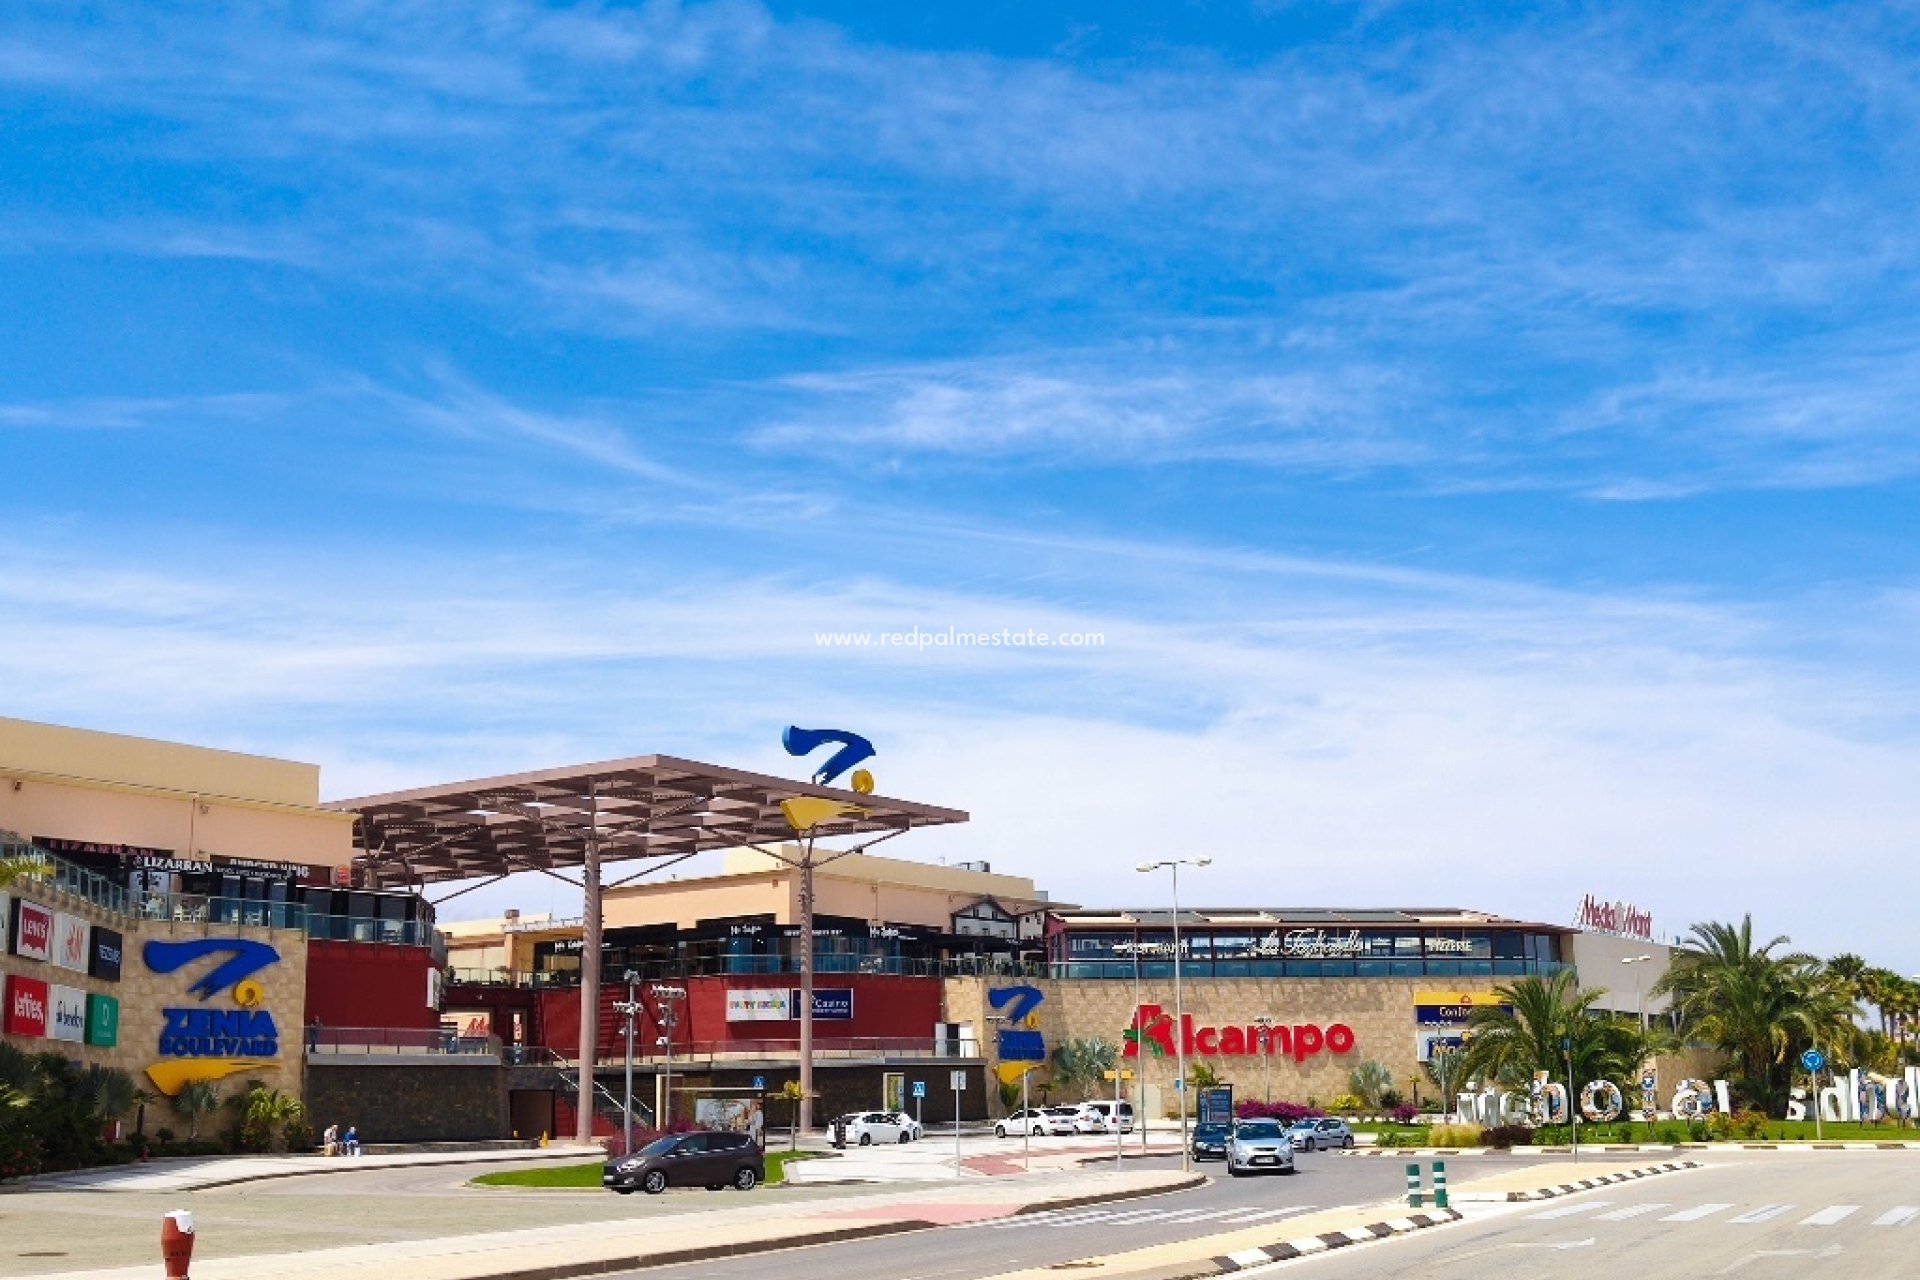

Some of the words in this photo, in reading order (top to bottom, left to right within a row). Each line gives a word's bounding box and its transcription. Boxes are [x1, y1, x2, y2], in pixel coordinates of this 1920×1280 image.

[143, 855, 213, 874] LIZARRAN
[161, 1008, 278, 1038] ZENIA
[1122, 1003, 1355, 1063] Alcampo
[159, 1037, 278, 1056] BOULEVARD
